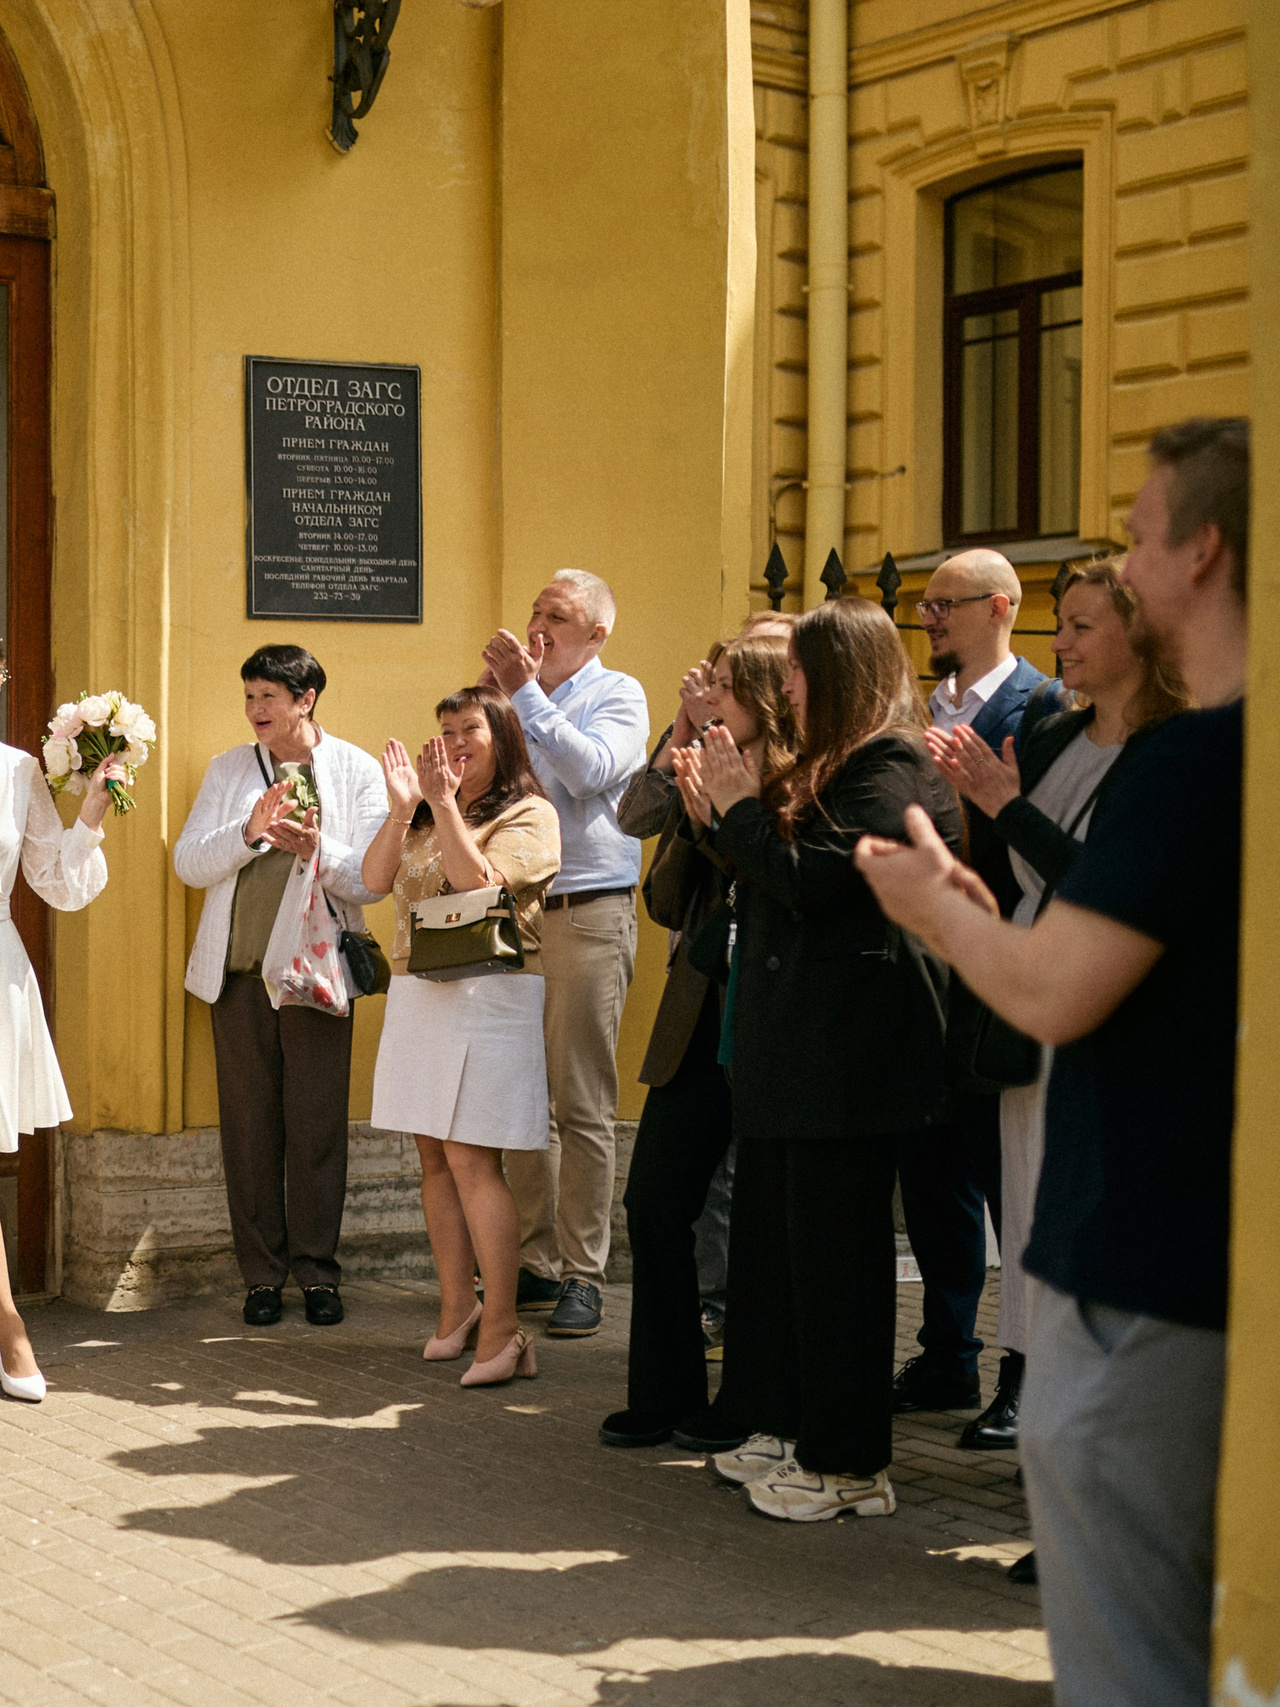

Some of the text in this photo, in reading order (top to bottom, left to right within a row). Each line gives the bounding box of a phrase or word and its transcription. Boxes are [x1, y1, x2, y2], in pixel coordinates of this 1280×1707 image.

[267, 376, 402, 400] ОТДЕЛ ЗАГС
[265, 397, 406, 417] ПЕТРОГРАДСКОГО
[305, 414, 366, 431] РАЙОНА
[282, 437, 389, 453] ПРИЕМ ГРАЖДАН
[282, 488, 391, 502] ПРИЕМ ГРАЖДАН
[292, 502, 383, 515] НАЧАЛЬНИКОМ
[294, 515, 379, 528] ОТДЕЛА ЗАГС
